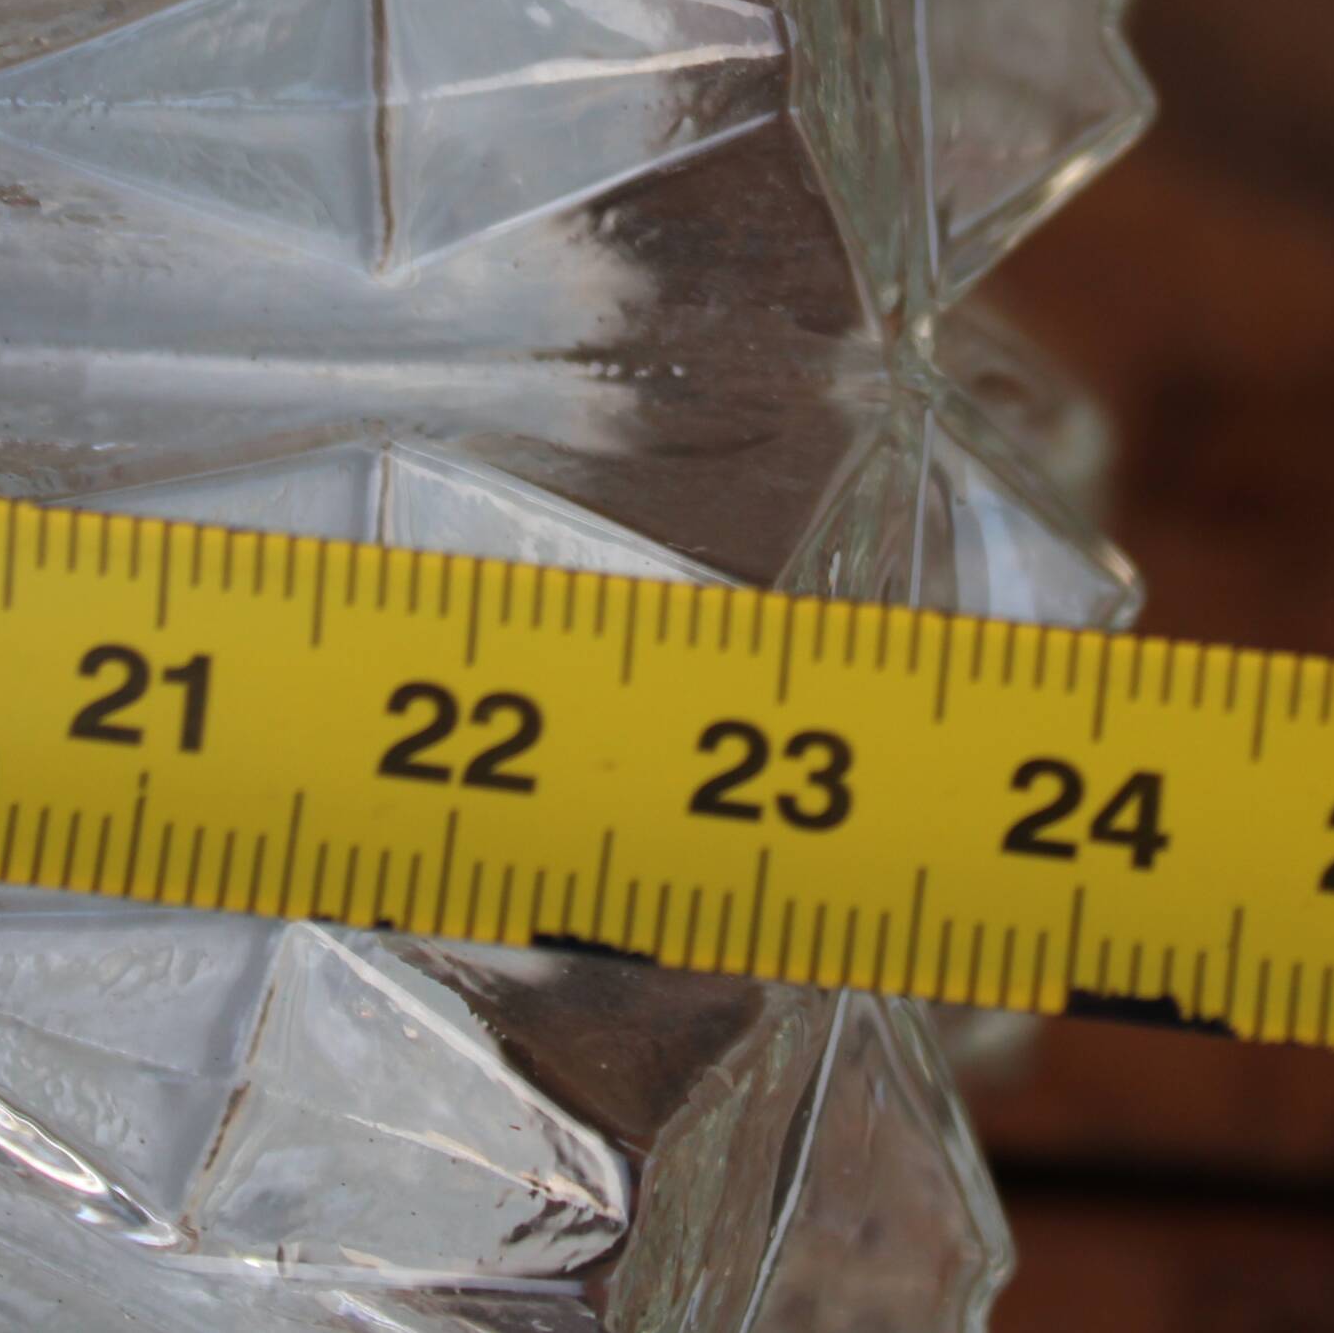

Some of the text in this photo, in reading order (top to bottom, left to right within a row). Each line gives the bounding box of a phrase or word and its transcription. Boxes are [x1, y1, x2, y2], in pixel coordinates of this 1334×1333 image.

[70, 645, 212, 753] 21
[378, 682, 542, 794] 22
[689, 720, 854, 833] 23
[1002, 758, 1170, 871] 24
